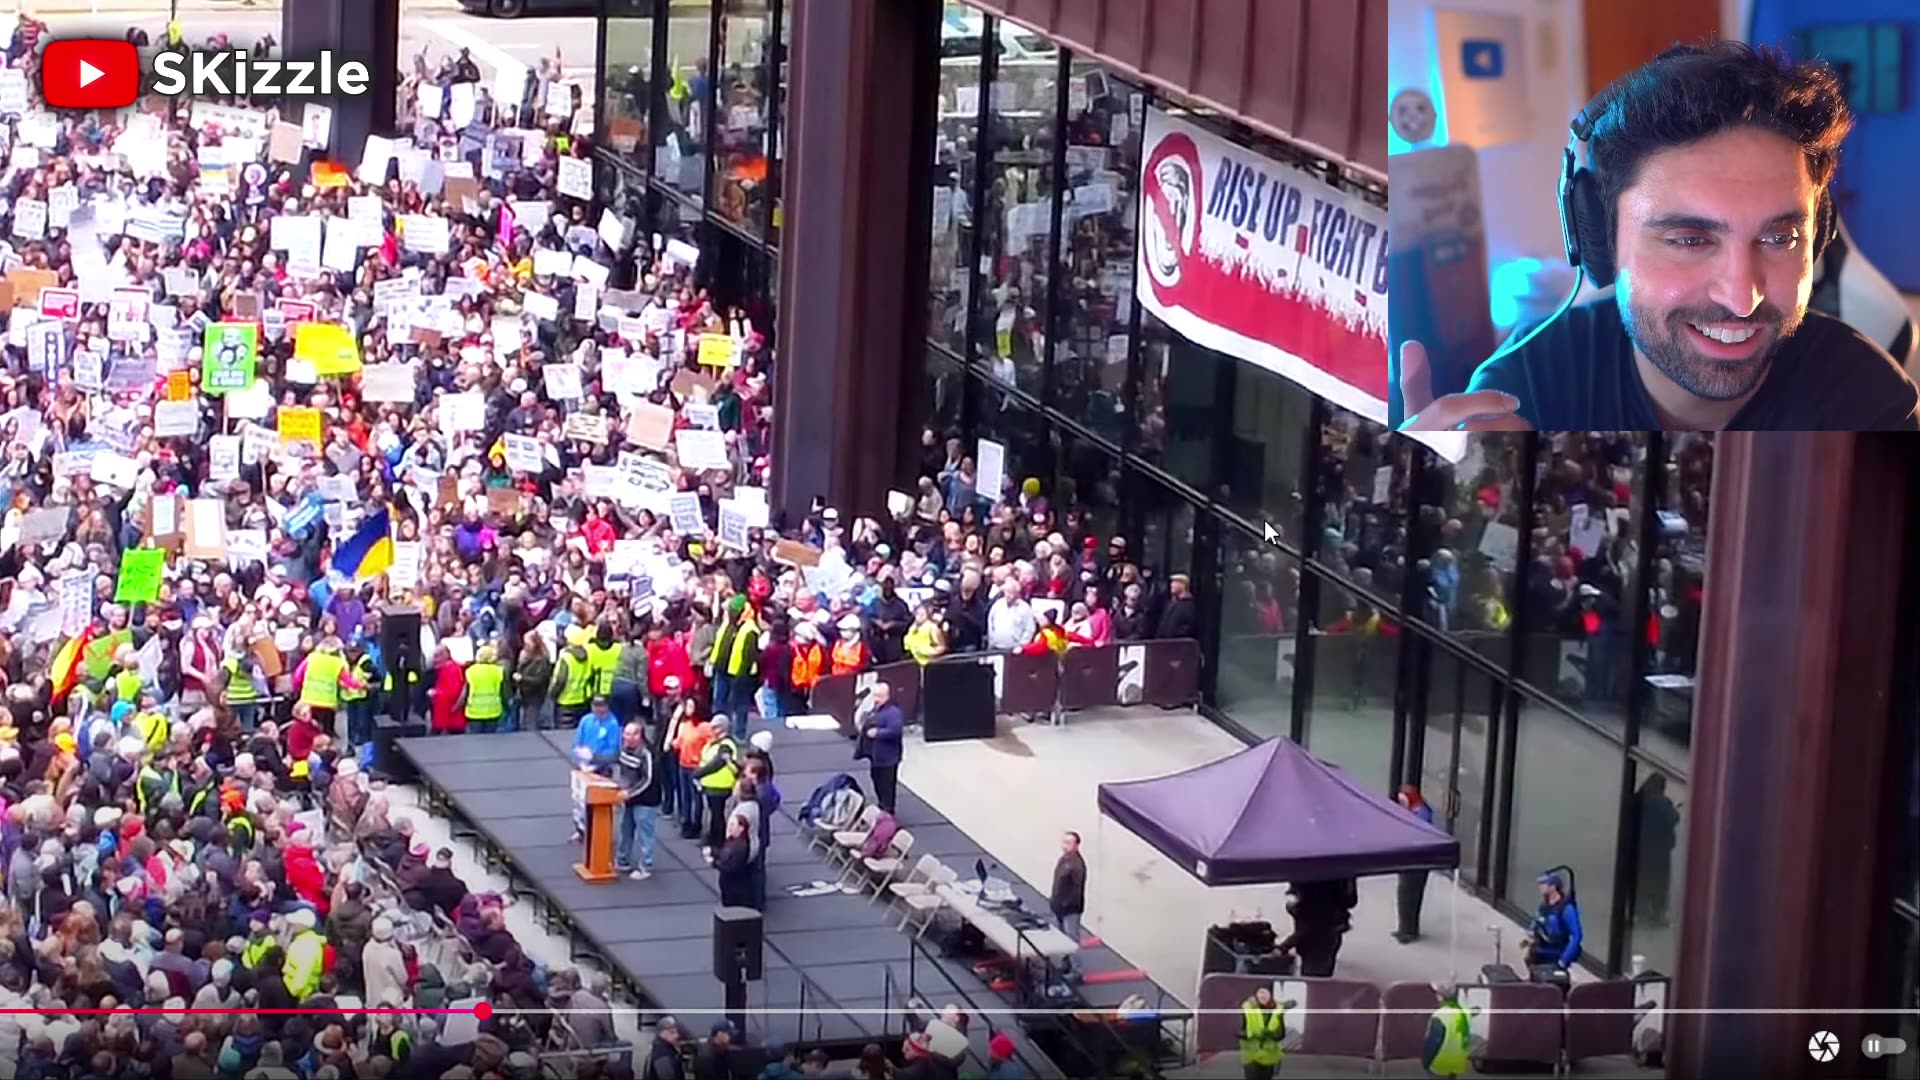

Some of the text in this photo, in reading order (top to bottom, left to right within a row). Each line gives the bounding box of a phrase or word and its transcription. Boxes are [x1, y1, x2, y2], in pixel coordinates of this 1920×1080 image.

[1206, 156, 1267, 233] RISE
[1263, 180, 1302, 246] UP
[1308, 199, 1377, 285] FIGHT
